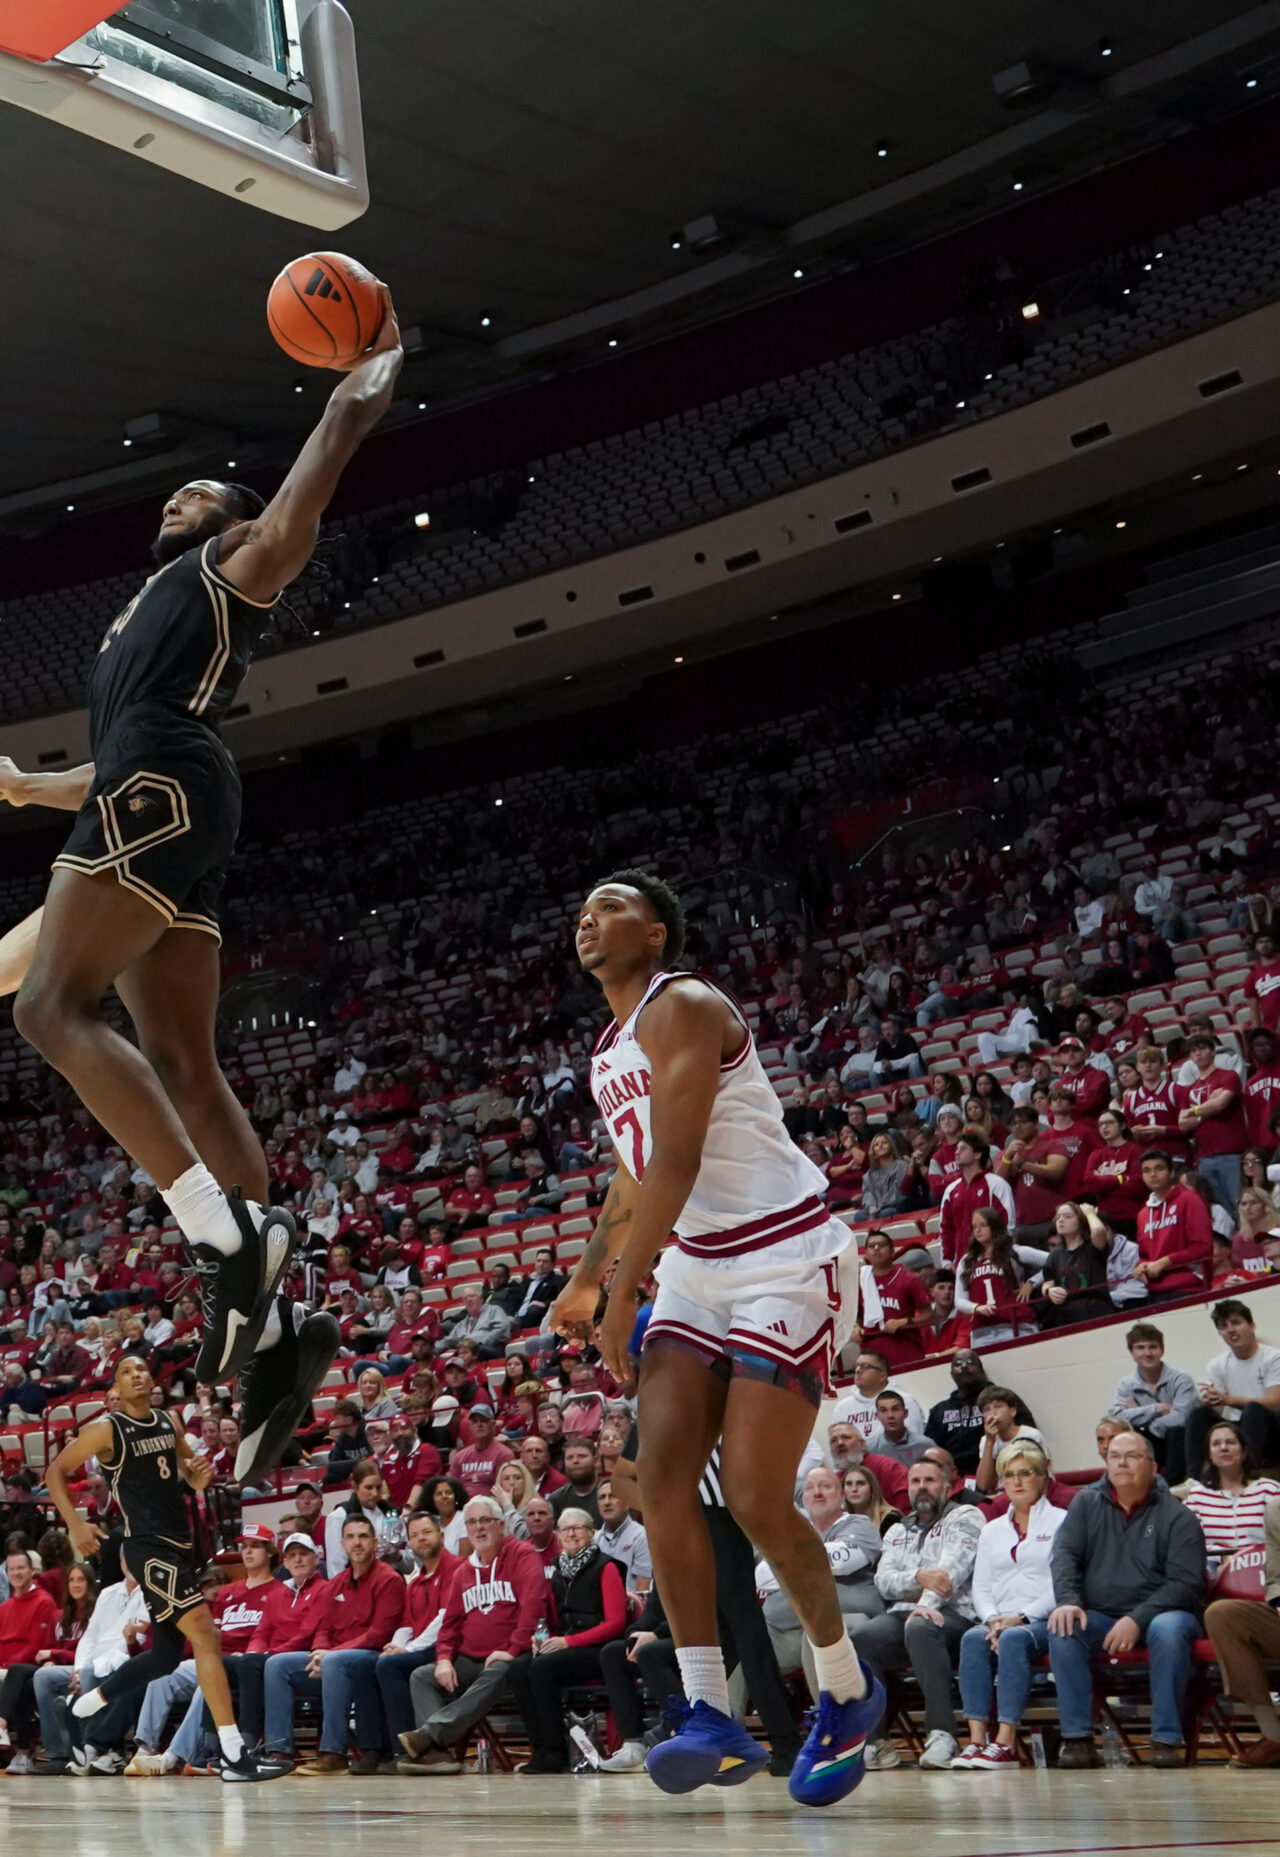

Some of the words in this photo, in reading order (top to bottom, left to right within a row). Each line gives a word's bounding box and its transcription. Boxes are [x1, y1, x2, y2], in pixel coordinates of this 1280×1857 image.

[613, 1106, 647, 1184] 7
[982, 1278, 996, 1305] 1
[157, 1455, 171, 1480] 8
[1229, 1551, 1267, 1574] INDI
